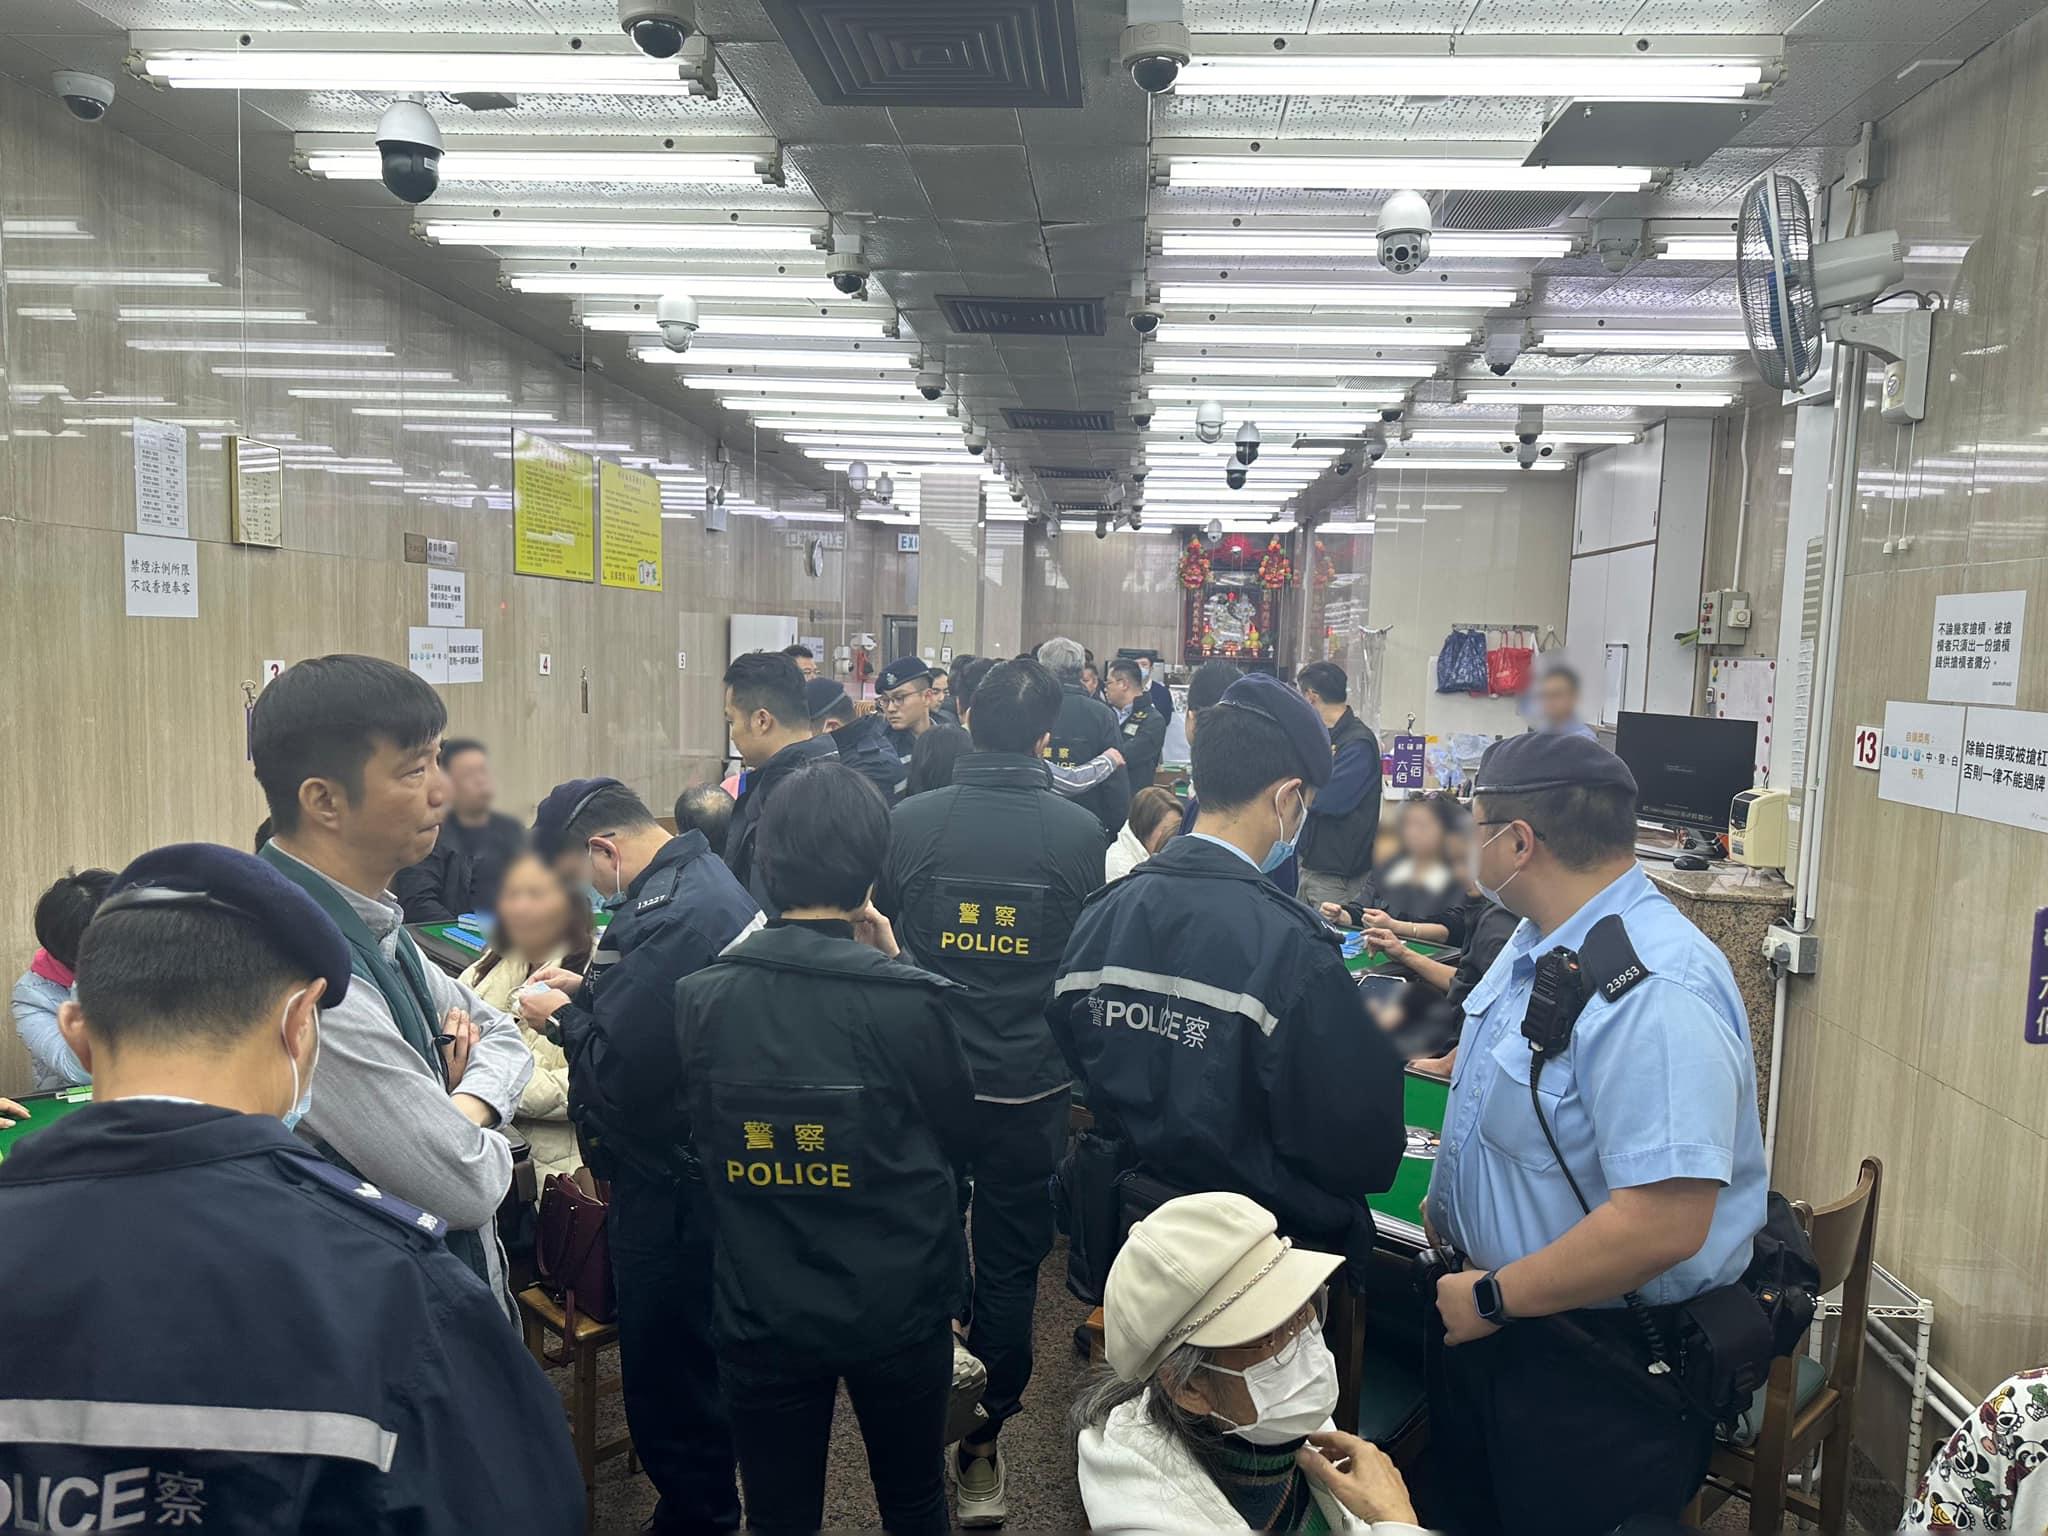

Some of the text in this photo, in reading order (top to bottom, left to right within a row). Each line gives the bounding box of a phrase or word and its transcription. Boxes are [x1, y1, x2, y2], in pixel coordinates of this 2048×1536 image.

[131, 580, 191, 595] 不設香煙奉客
[543, 656, 548, 672] 4
[1857, 730, 1877, 764] 13
[959, 903, 1017, 927] 警 察
[941, 931, 1030, 955] POLICE
[1606, 966, 1640, 994] 23953
[1183, 1016, 1210, 1049] 察
[743, 1121, 825, 1151] 警 察
[727, 1160, 852, 1188] POLICE
[153, 1470, 209, 1526] 察
